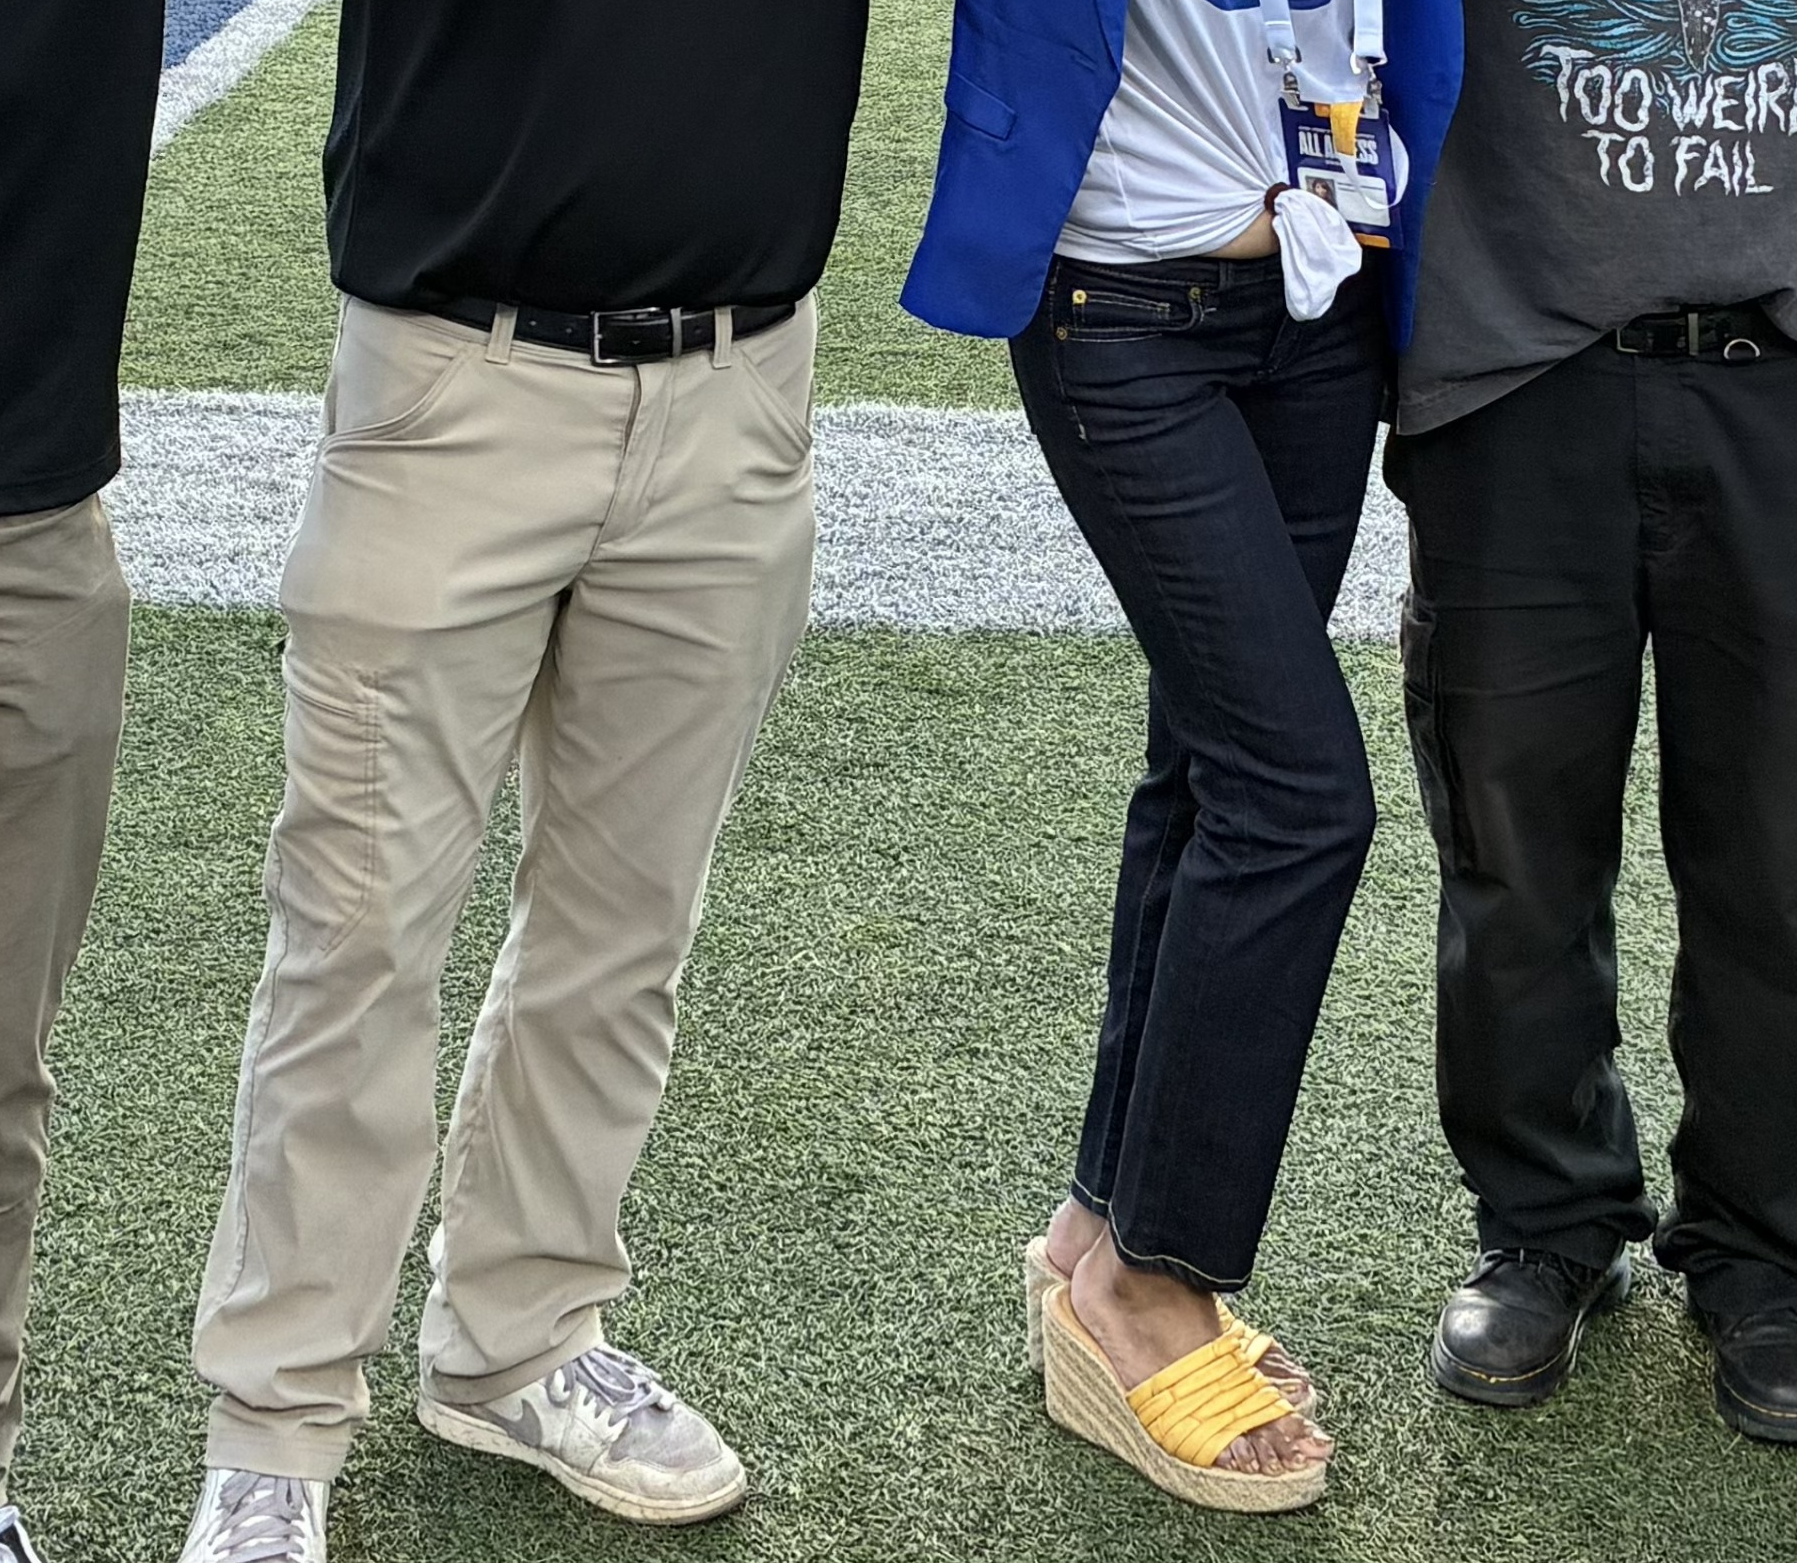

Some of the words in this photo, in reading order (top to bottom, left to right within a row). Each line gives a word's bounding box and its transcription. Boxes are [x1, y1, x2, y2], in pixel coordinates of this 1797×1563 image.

[1540, 45, 1650, 132] TOO
[1298, 130, 1324, 158] ALL
[1582, 129, 1655, 193] TO
[1672, 134, 1774, 196] FAIL
